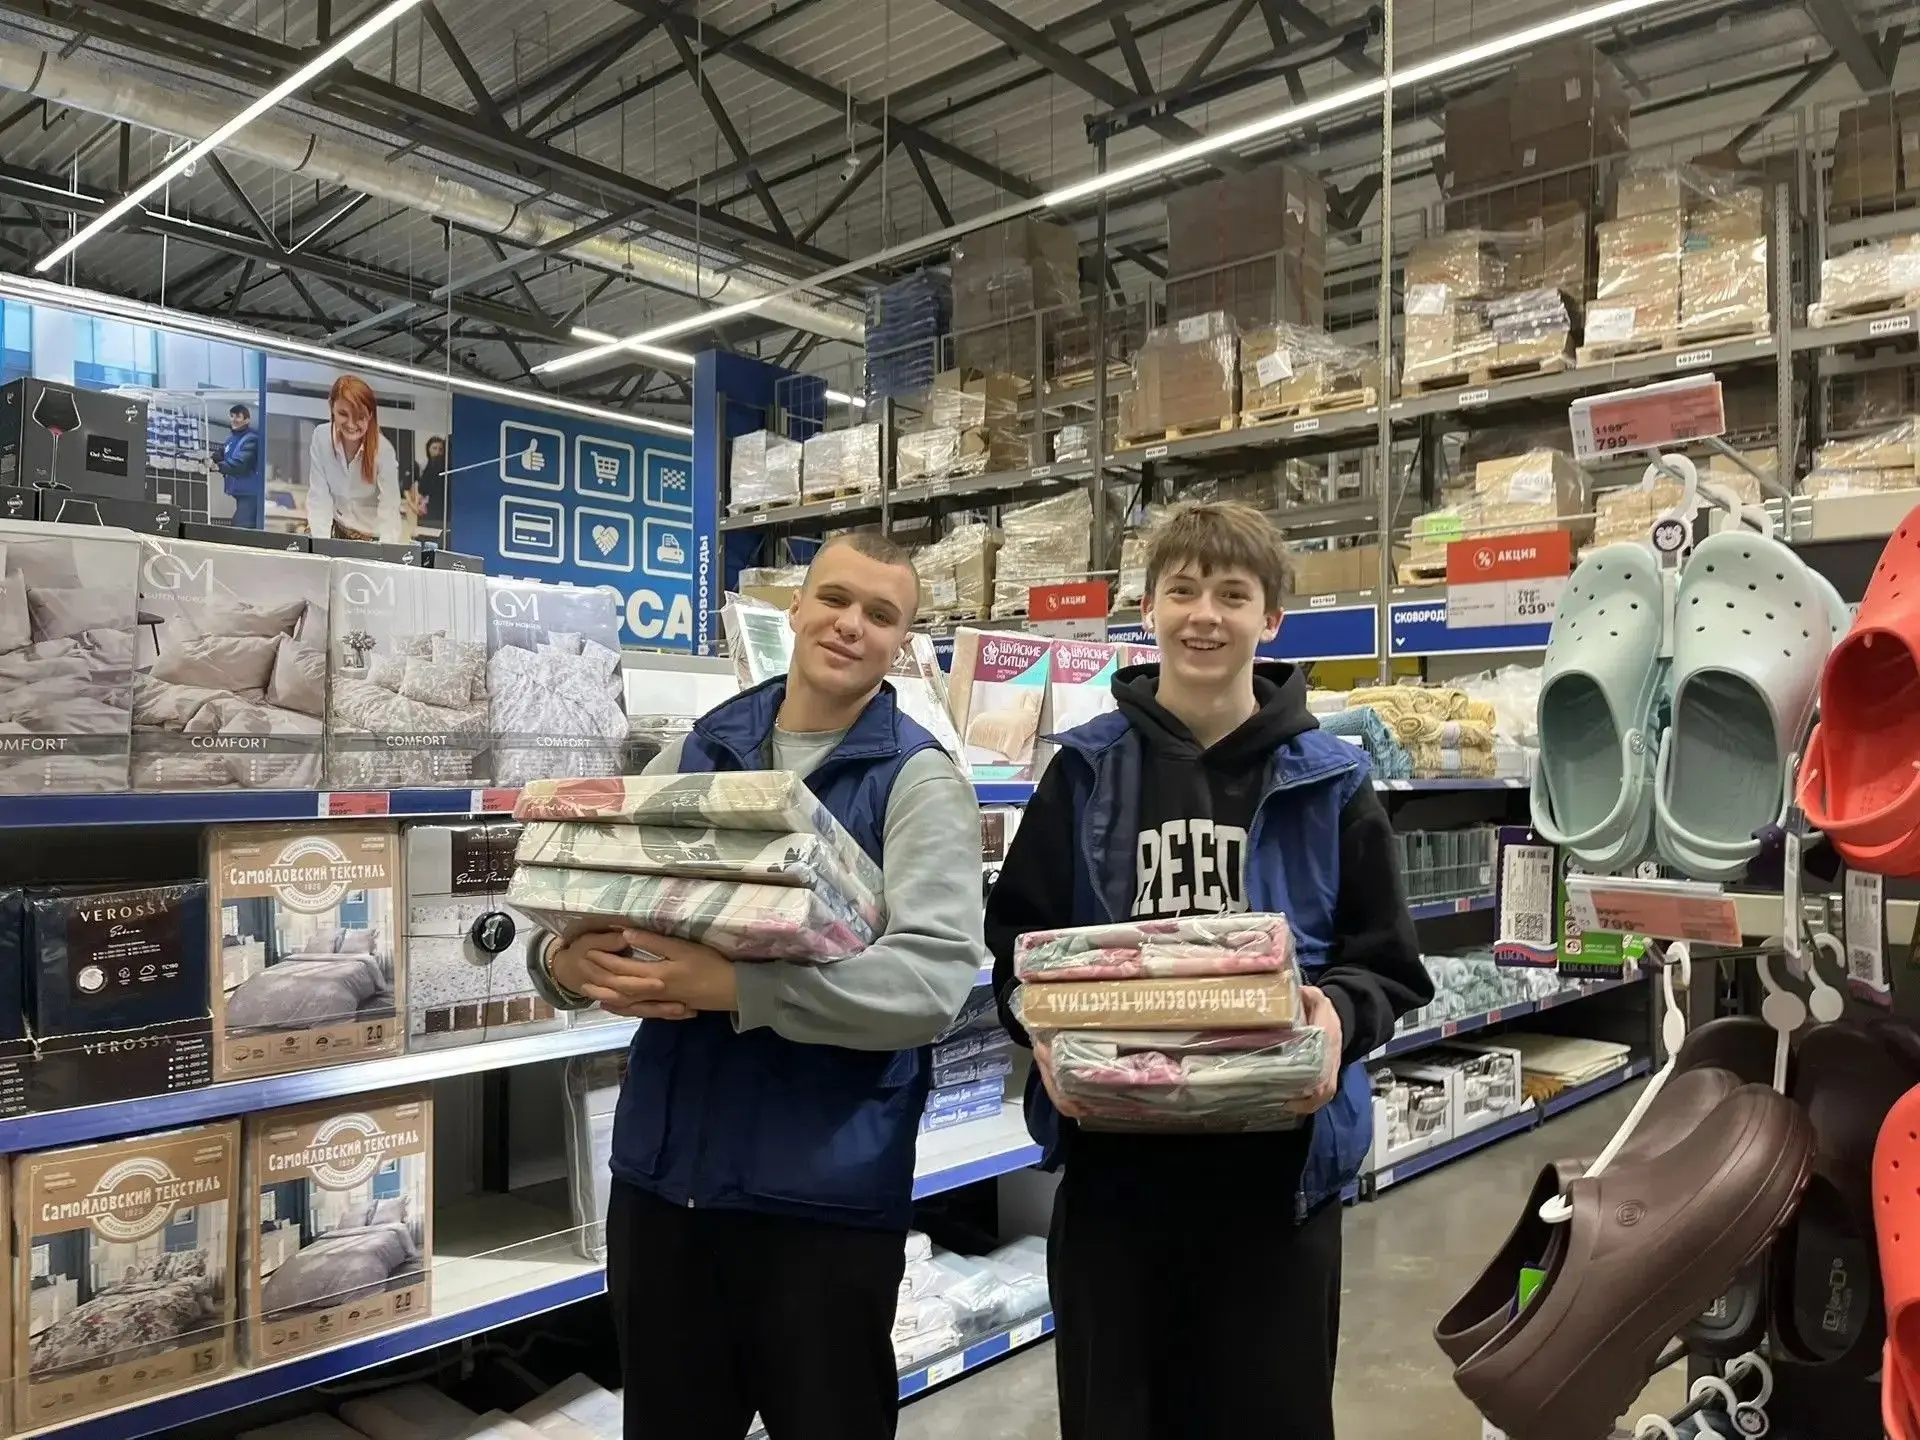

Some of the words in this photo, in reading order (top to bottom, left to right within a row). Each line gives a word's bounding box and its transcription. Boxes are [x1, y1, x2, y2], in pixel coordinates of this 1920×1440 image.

[1596, 437, 1628, 451] 799
[1498, 548, 1537, 562] АКЦИЯ
[340, 571, 395, 606] GM
[698, 535, 710, 643] СКОВОРОДЫ
[490, 589, 540, 620] GM
[1060, 595, 1087, 606] АКЦИЯ
[1518, 604, 1546, 615] 639
[999, 643, 1042, 657] ШУЙСКИЕ
[1071, 646, 1110, 661] ШУЙСКИЕ
[999, 655, 1029, 669] СИТЦЫ
[1072, 658, 1100, 671] СИТЦЫ
[191, 736, 268, 749] COMFORT
[386, 735, 448, 747] COMFORT
[536, 736, 591, 748] COMFORT
[330, 863, 386, 881] ТЕКСТИЛЬ
[1131, 818, 1250, 917] REED
[80, 900, 170, 922] VEROSSA
[83, 1034, 173, 1055] VEROSSA
[363, 1130, 419, 1152] ТЕКСТИЛЬ
[155, 1175, 221, 1200] ТЕКСТИЛЬ
